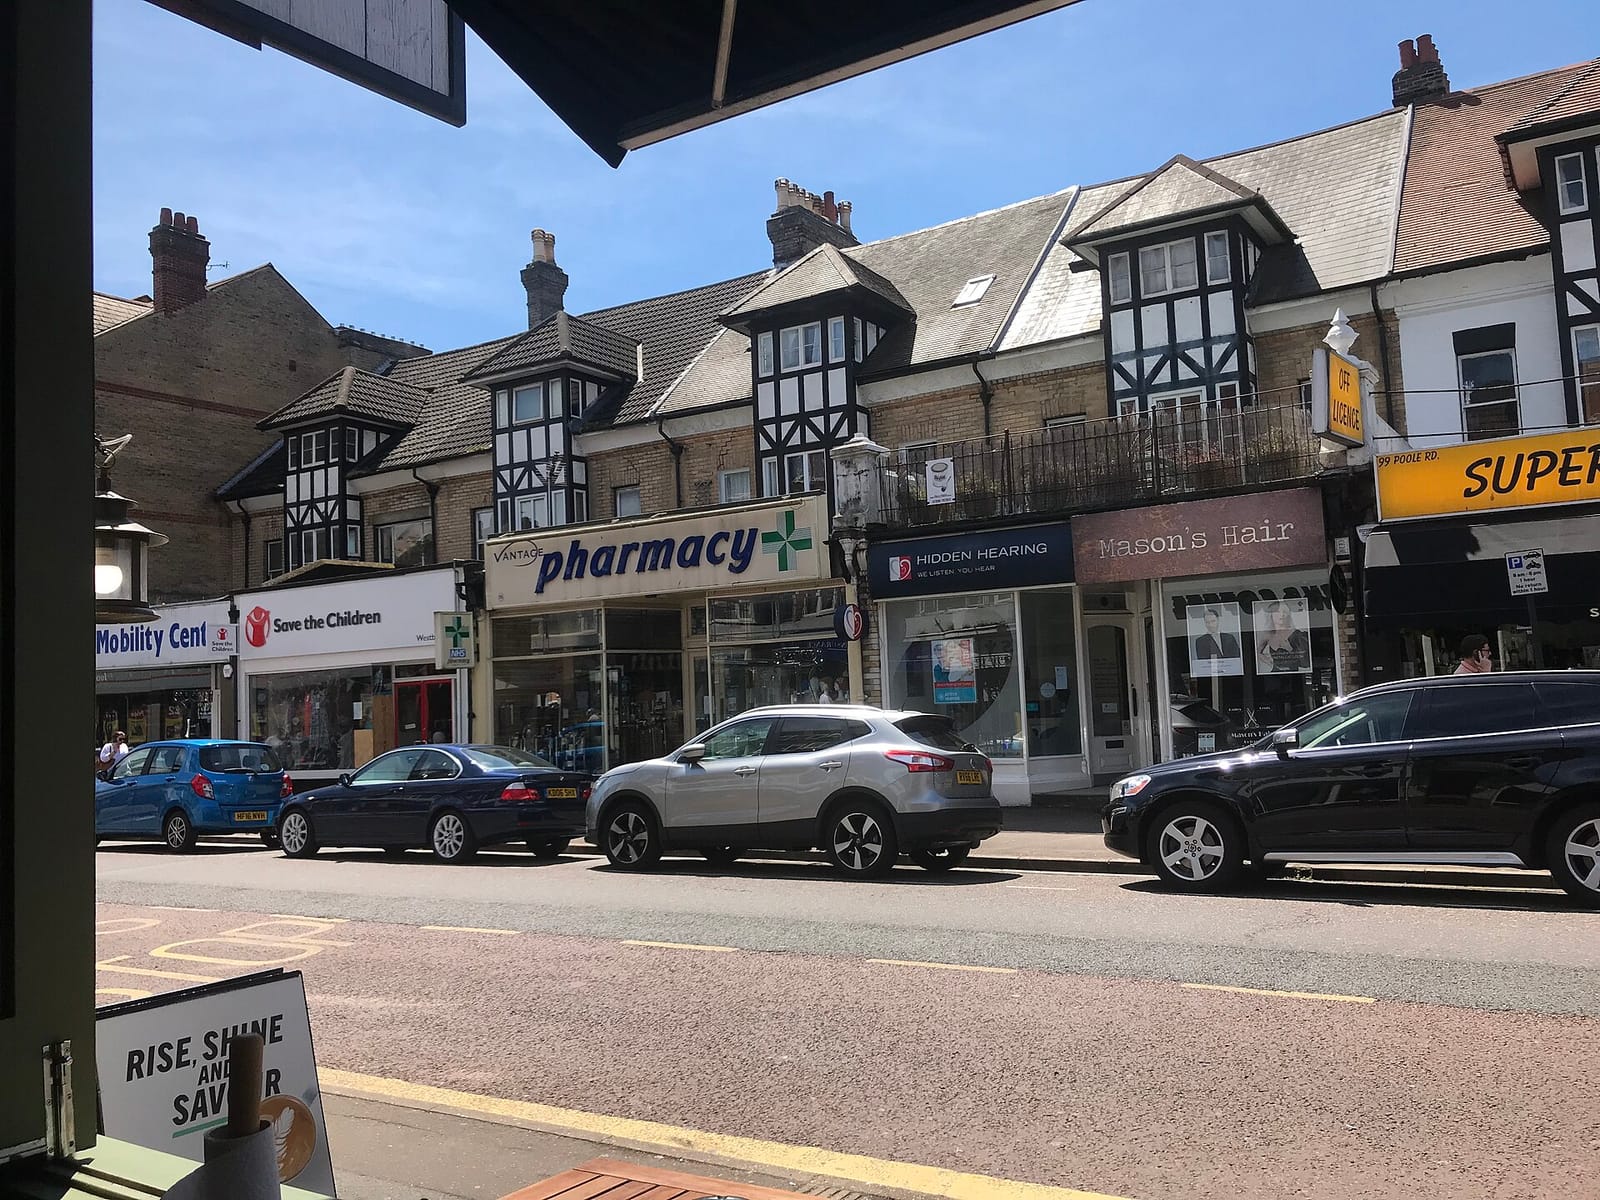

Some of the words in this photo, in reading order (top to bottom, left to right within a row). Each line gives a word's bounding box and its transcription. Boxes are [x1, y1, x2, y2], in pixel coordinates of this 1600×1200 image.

[1338, 367, 1351, 393] OFF
[1332, 399, 1360, 431] LICENCE
[1378, 457, 1391, 468] 99
[1394, 453, 1422, 465] POOLE
[1425, 450, 1440, 462] RD.
[1099, 527, 1208, 559] Mason's
[1221, 519, 1295, 547] Hair
[494, 548, 543, 563] VANTAGE
[535, 528, 758, 594] pharmacy
[916, 550, 972, 565] HIDDEN
[977, 542, 1048, 560] HEARING
[1512, 558, 1520, 568] P
[274, 617, 301, 633] Save
[304, 614, 325, 630] the
[326, 610, 381, 628] Children
[96, 624, 164, 657] Mobility
[125, 1037, 198, 1082] RISE,
[197, 1060, 231, 1086] AND
